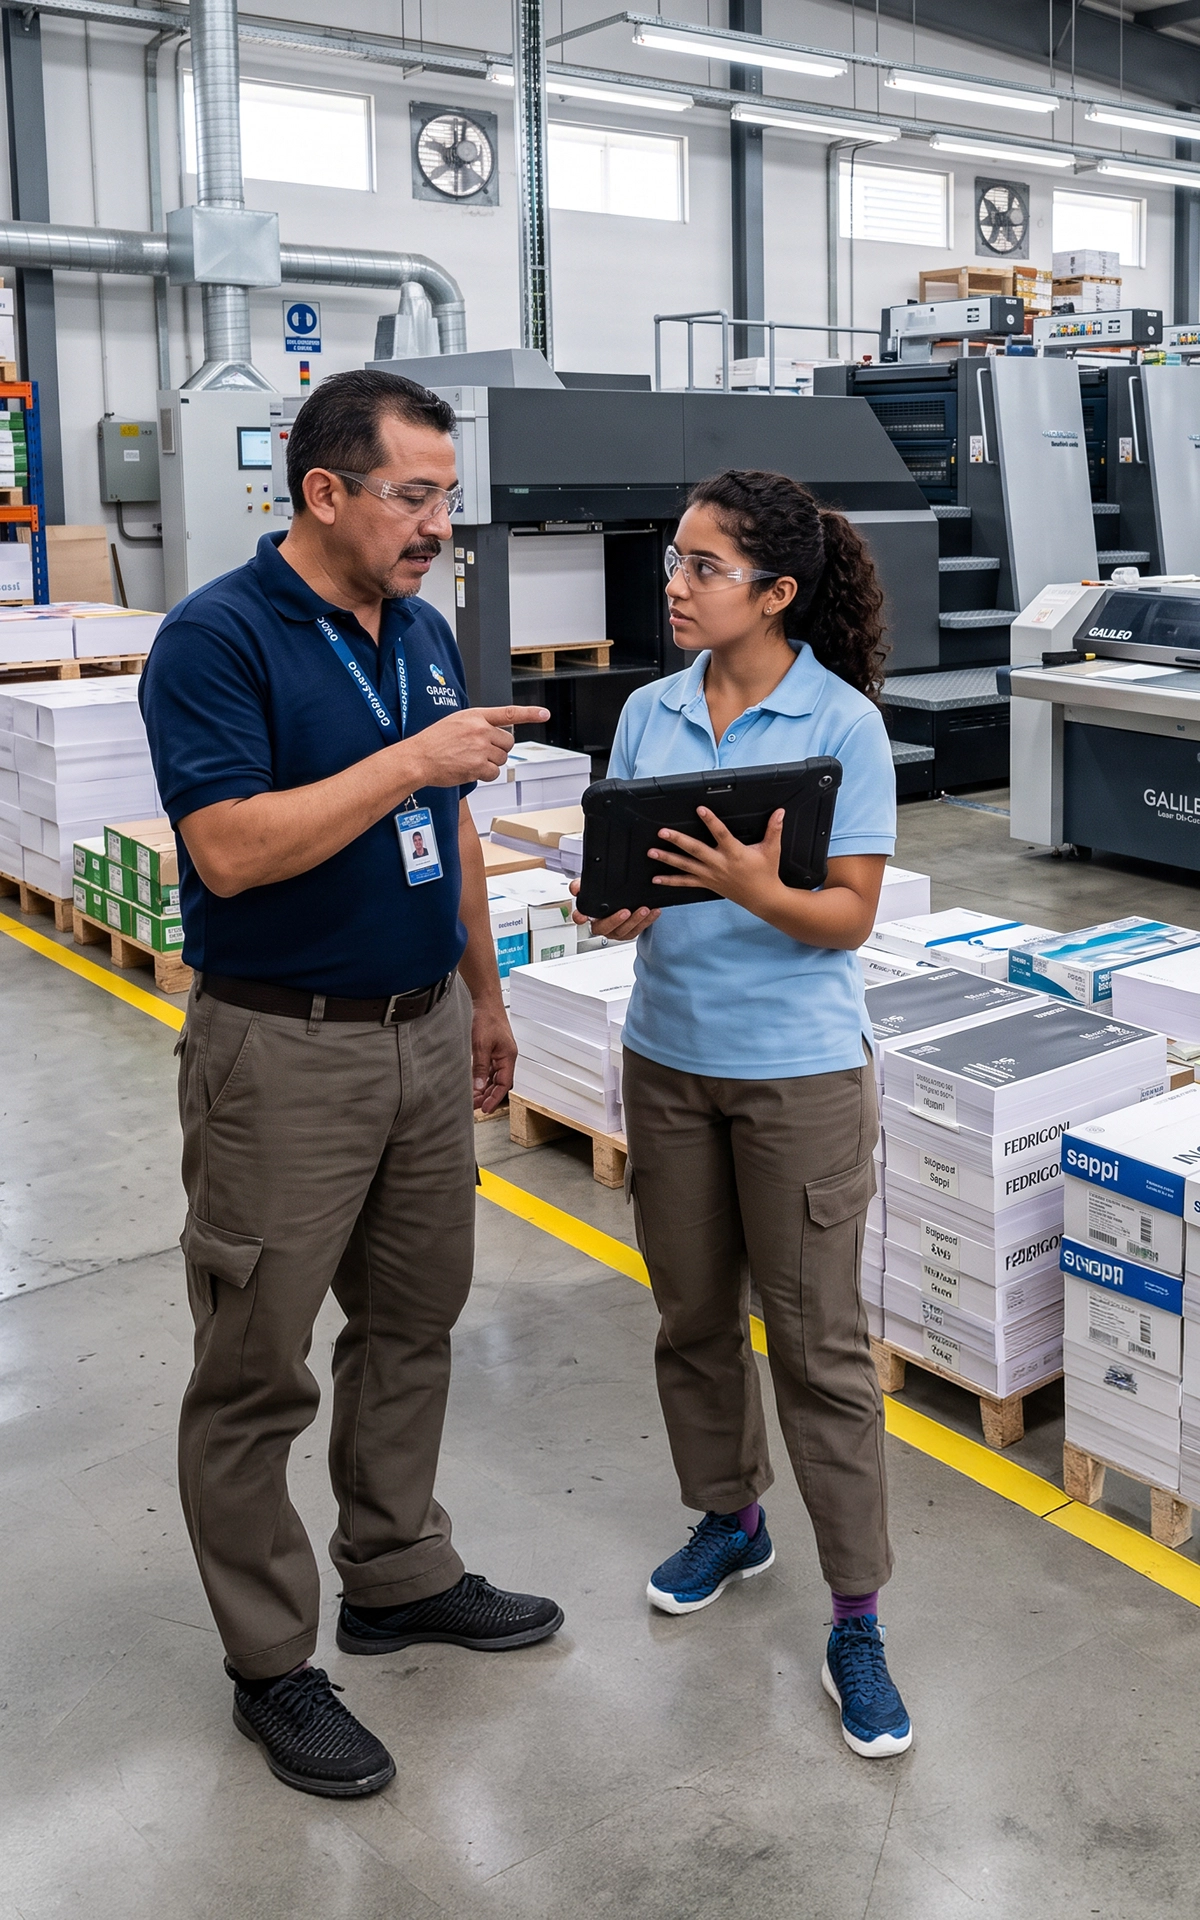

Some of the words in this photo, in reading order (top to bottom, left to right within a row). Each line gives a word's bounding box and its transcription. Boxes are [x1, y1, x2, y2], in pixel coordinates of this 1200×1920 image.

[1004, 1121, 1069, 1156] FEDRIGONI
[1006, 1162, 1062, 1196] FEDRIGO
[1066, 1149, 1119, 1181] sappi
